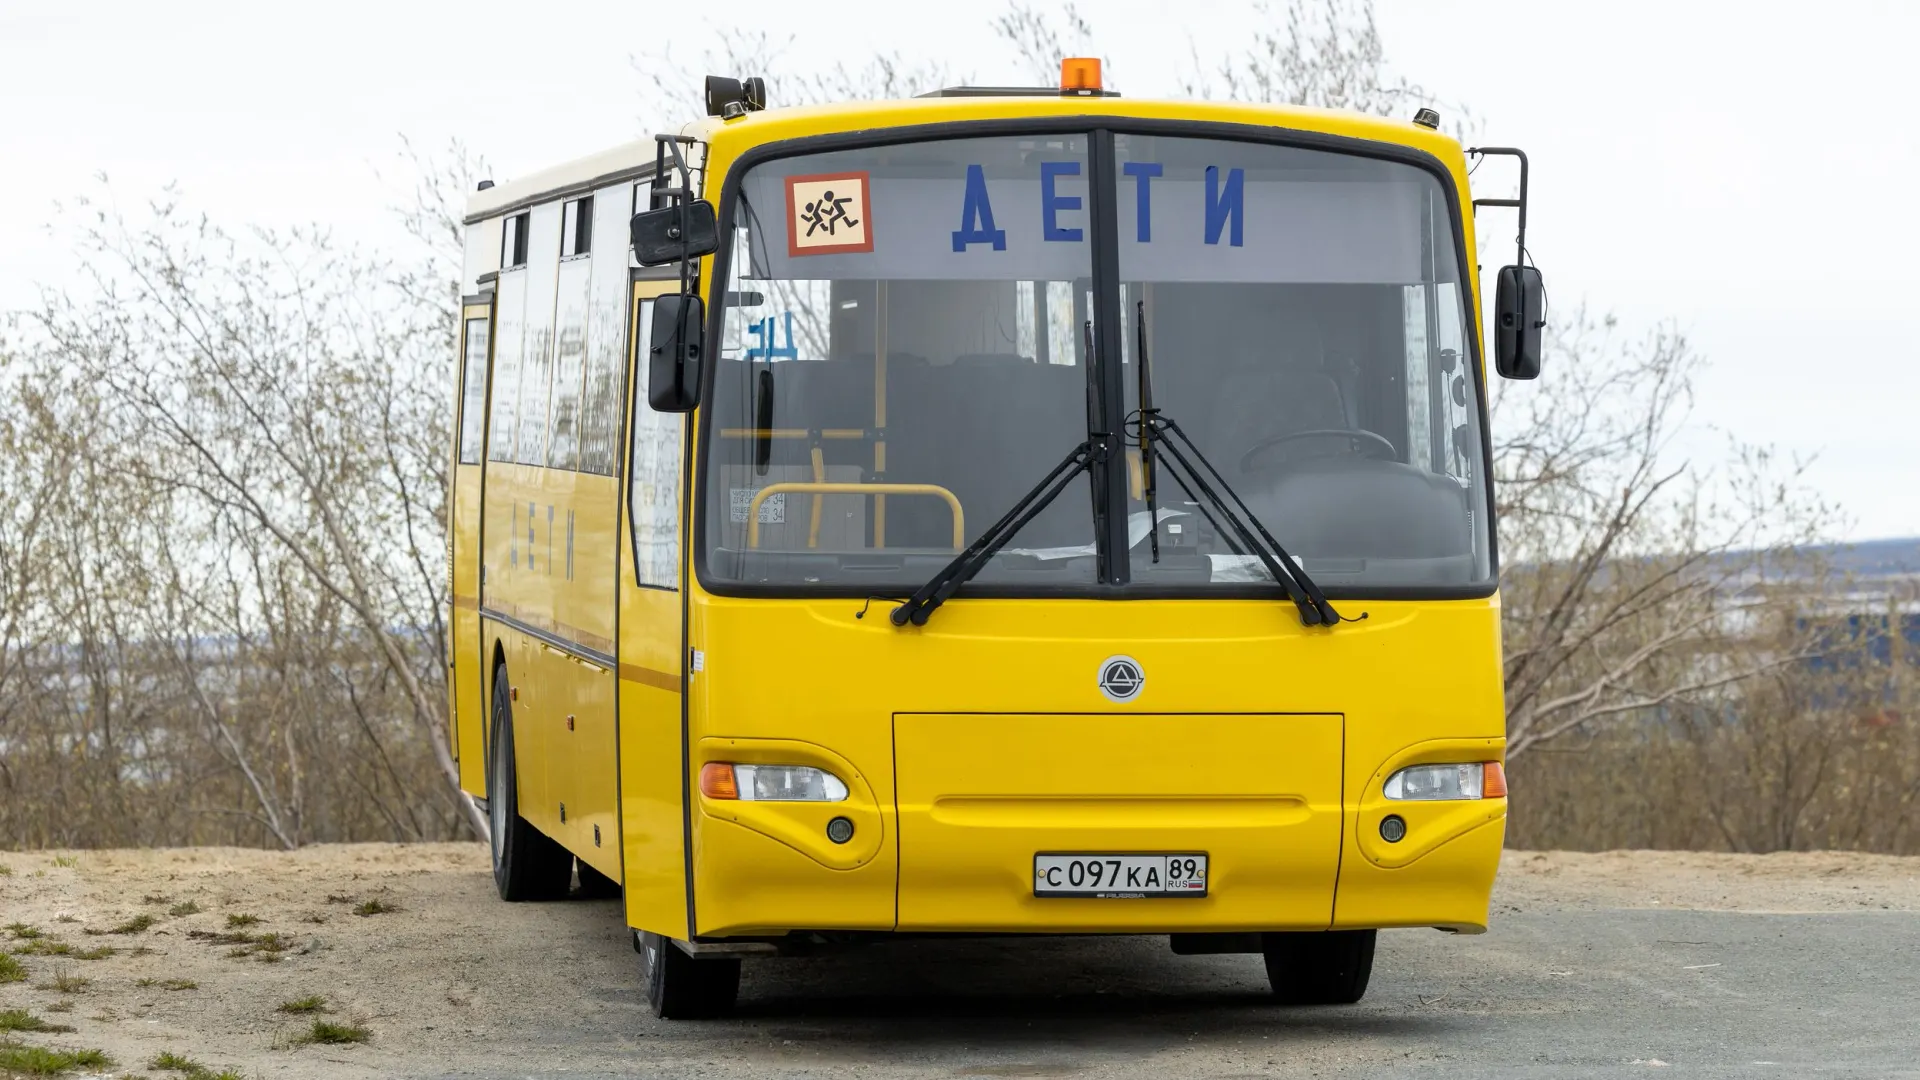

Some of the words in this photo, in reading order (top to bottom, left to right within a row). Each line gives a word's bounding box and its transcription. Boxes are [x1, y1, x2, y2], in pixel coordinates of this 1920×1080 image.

[952, 162, 1244, 252] ДЕТИ
[772, 508, 783, 521] 34
[1169, 859, 1196, 879] 89
